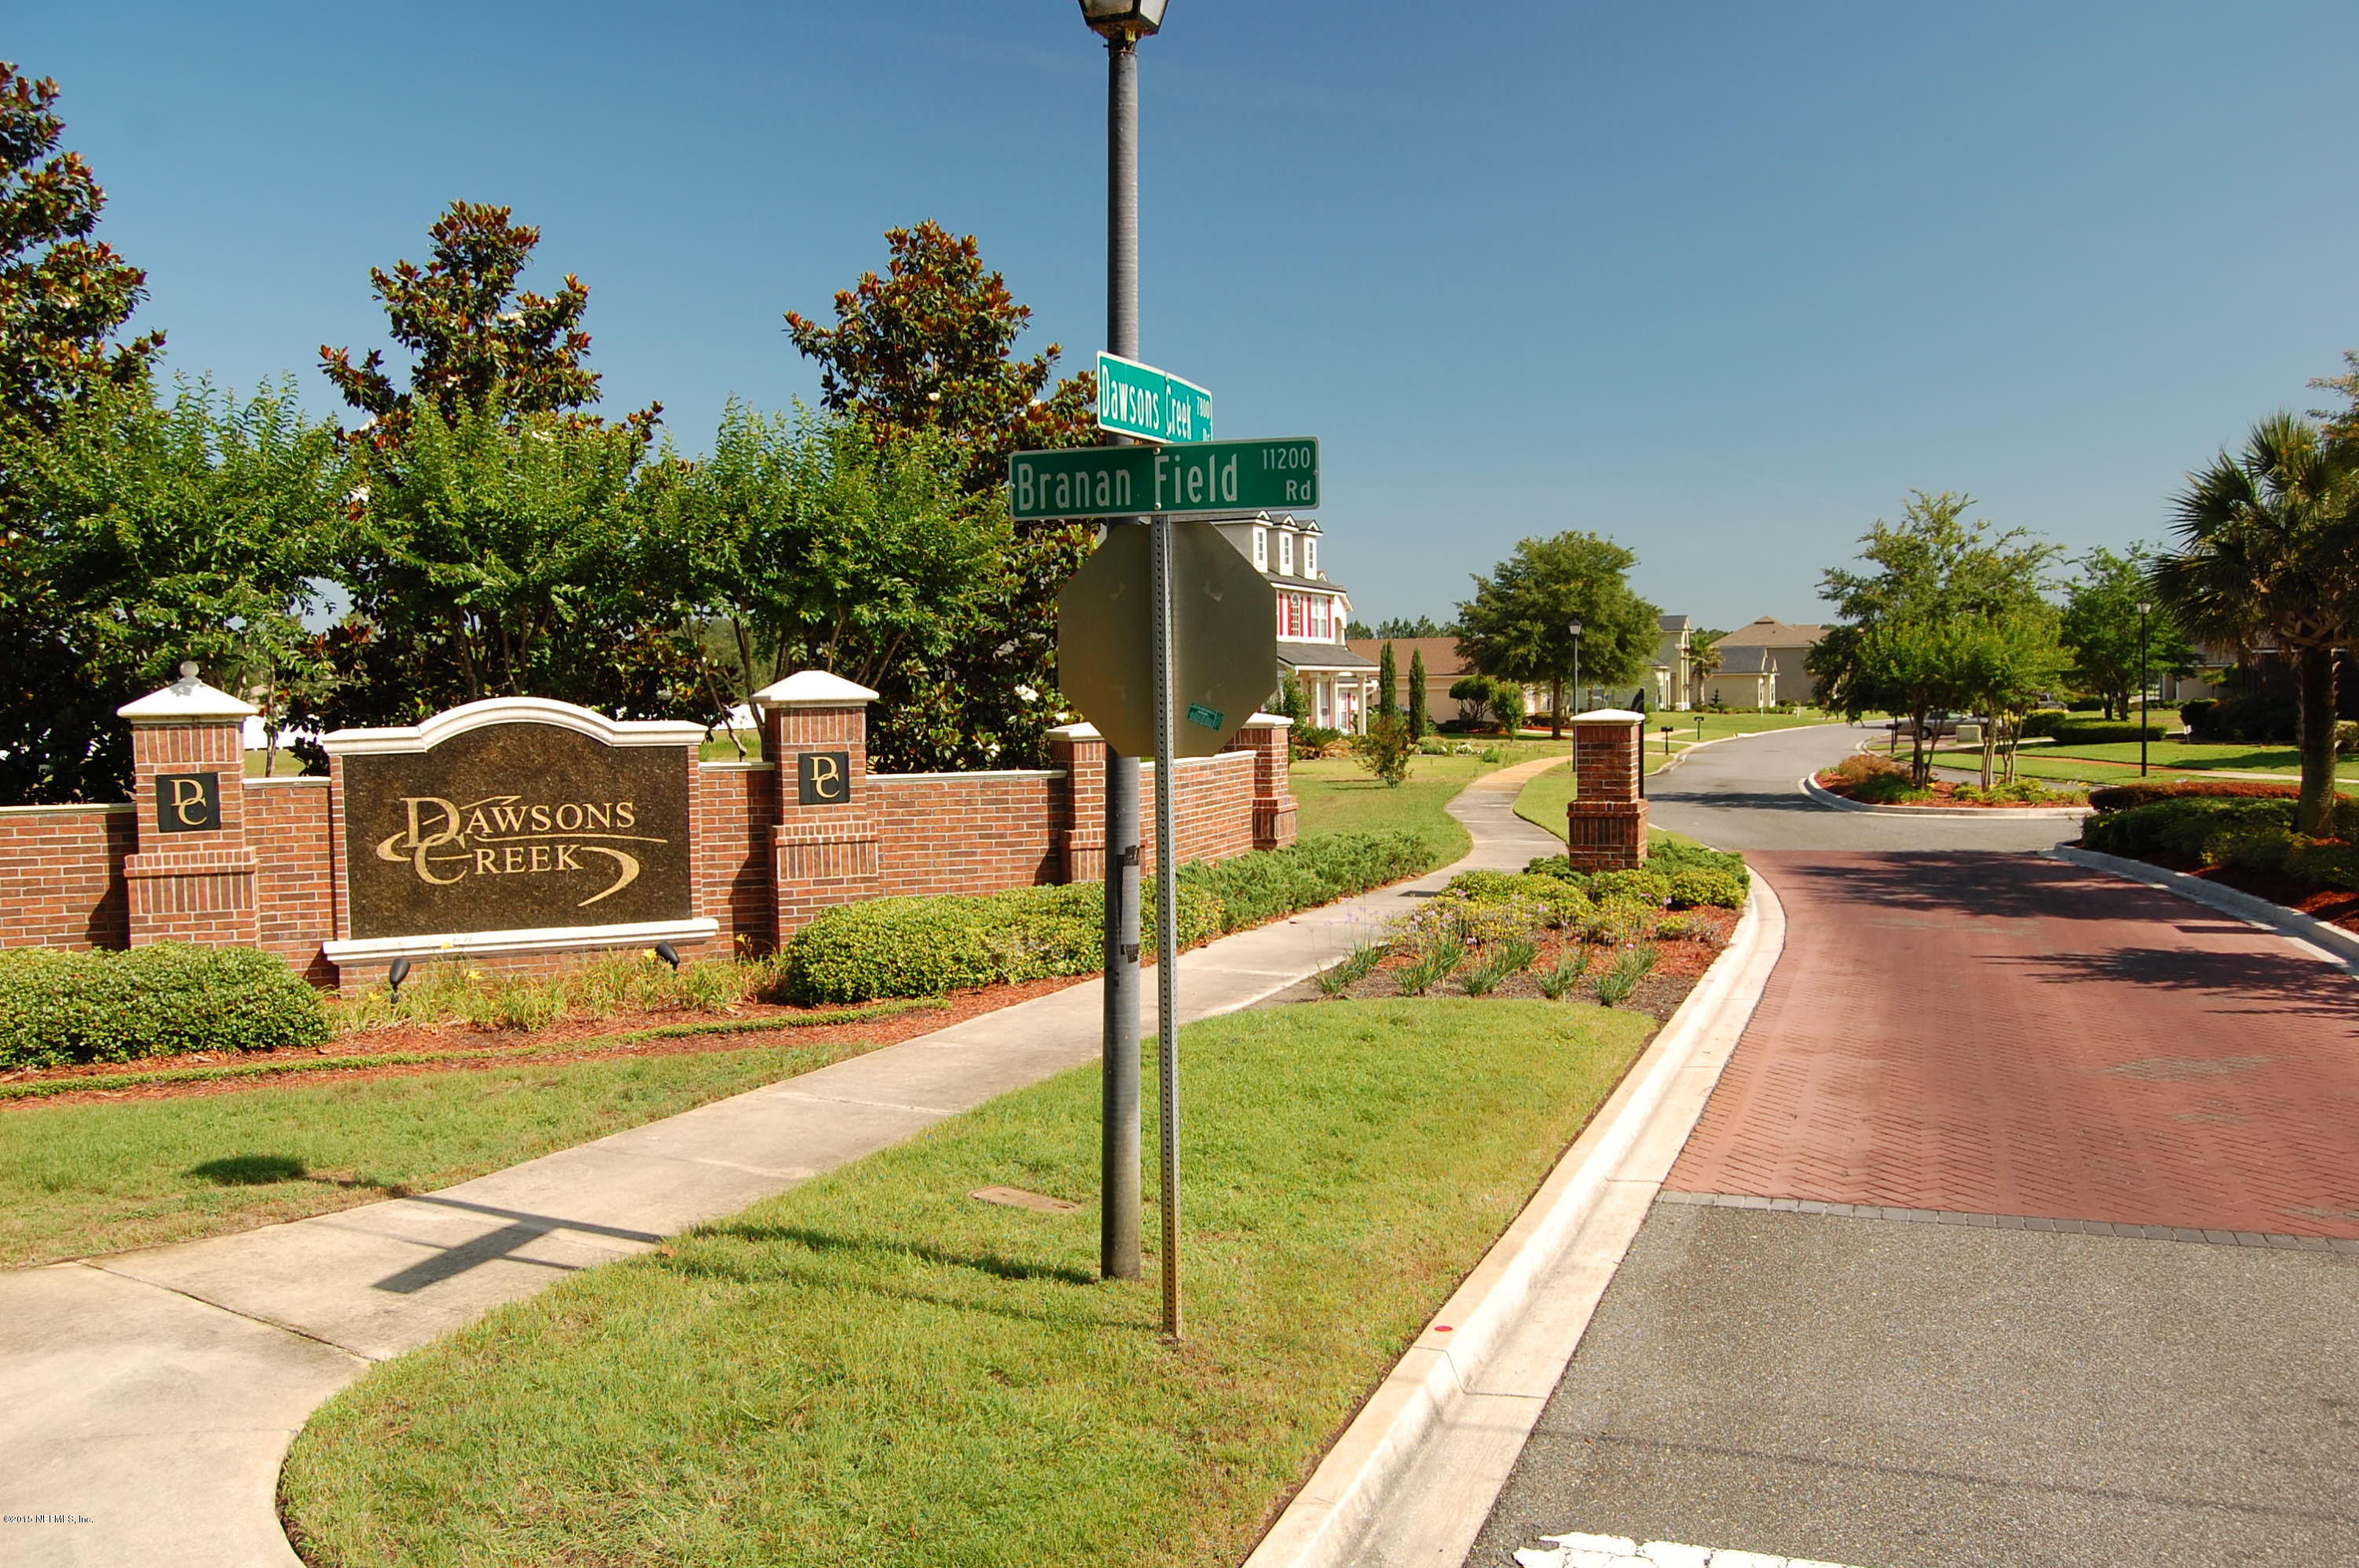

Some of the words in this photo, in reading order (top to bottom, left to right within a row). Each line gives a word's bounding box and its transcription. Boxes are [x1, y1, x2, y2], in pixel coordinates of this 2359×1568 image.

[1102, 363, 1160, 430] Dawsons
[1166, 385, 1192, 440] Creek
[1018, 462, 1131, 511] Branan
[1154, 453, 1238, 508] Field
[1262, 447, 1311, 470] 11200
[1286, 479, 1312, 502] Rd
[399, 797, 635, 848] DAWSONS
[414, 833, 583, 885] CREEK
